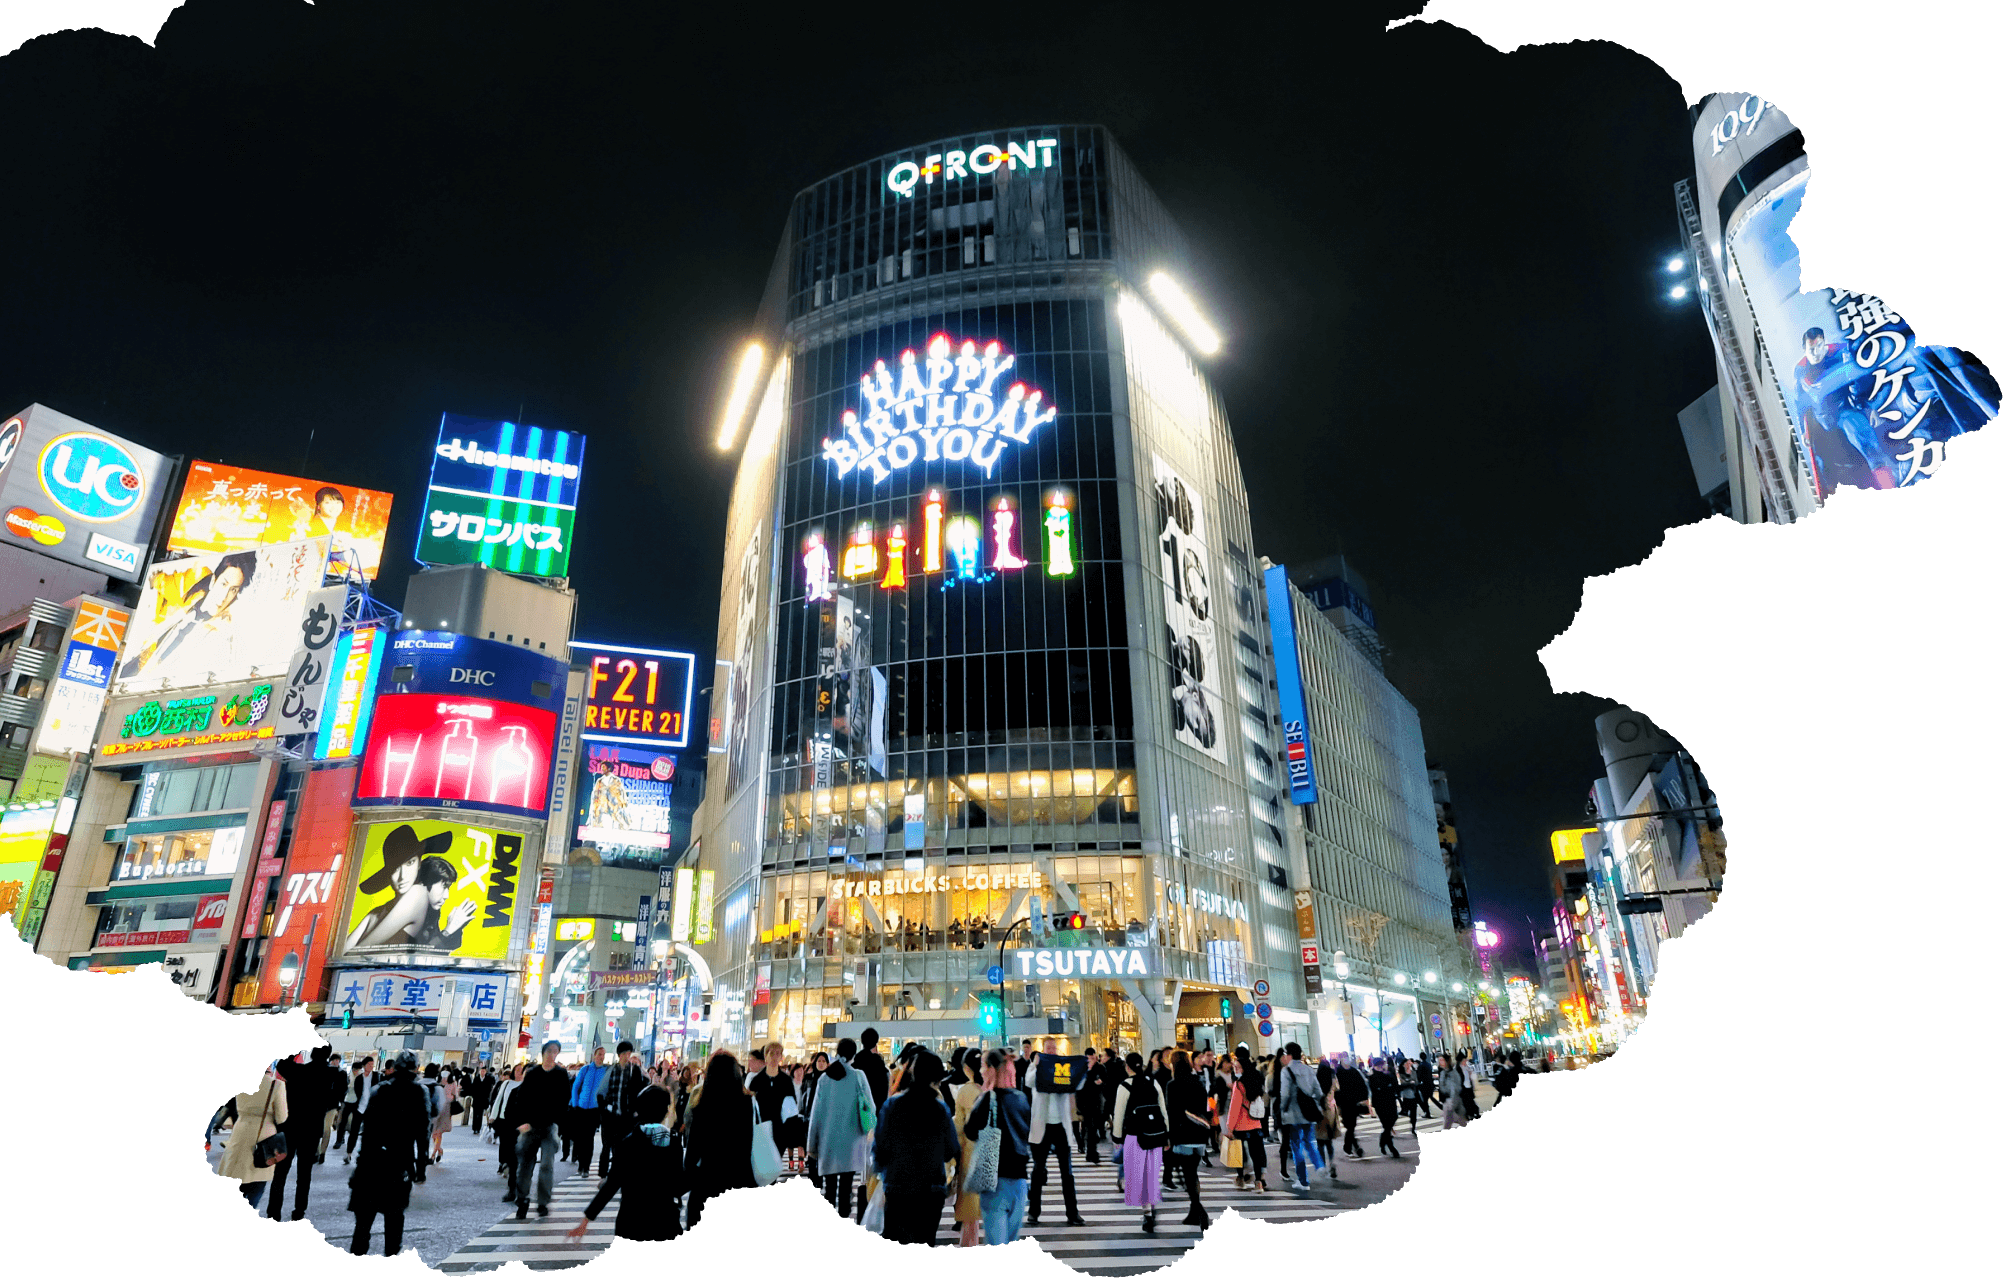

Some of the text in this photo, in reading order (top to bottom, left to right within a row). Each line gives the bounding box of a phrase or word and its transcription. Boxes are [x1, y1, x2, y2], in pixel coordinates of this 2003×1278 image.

[887, 138, 1057, 198] QFRONT
[862, 354, 1014, 418] HAPPY
[822, 393, 1057, 480] BIRTHDAY
[860, 427, 1008, 485] TO YOU
[451, 437, 579, 481] Hisamitsu
[5, 512, 67, 539] MasterCard
[429, 509, 564, 553] サロンパス
[96, 543, 135, 565] VISA
[72, 606, 127, 648] 本
[393, 639, 454, 650] DHC Channel
[281, 602, 337, 729] もんじゃ
[449, 667, 496, 687] DHC
[590, 656, 659, 705] F21
[659, 711, 682, 735] 21
[552, 696, 579, 813] Taisei neon
[1284, 720, 1310, 793] SEIBU
[442, 799, 460, 808] DHC
[119, 859, 202, 881] Euphoria
[457, 827, 493, 893] FX
[482, 833, 522, 928] DMM
[831, 870, 1043, 901] STARBUCKS COFFEE
[197, 899, 228, 923] JTB
[1016, 948, 1148, 977] TSUTAYA
[341, 978, 499, 1010] 大盛堂店
[1054, 1062, 1072, 1077] M
